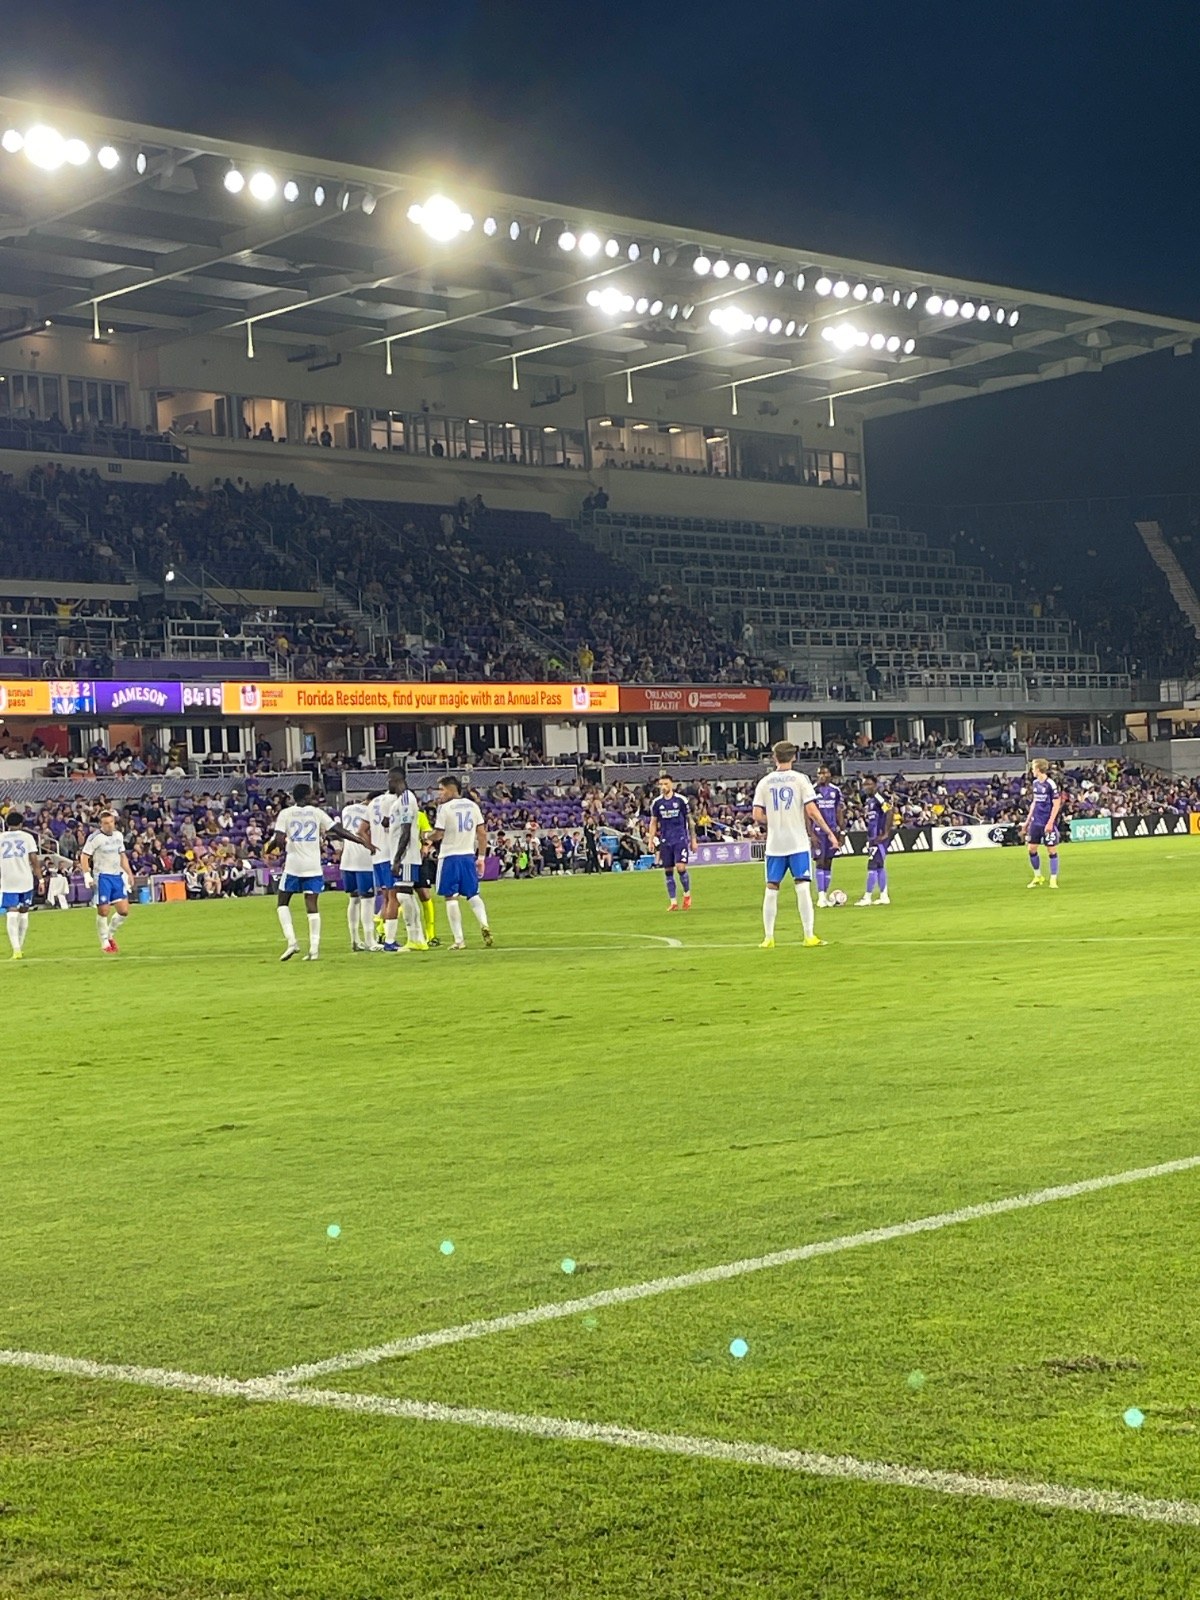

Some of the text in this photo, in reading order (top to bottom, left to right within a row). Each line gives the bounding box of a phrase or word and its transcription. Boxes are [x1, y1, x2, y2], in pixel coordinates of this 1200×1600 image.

[7, 687, 33, 697] annual
[82, 682, 91, 697] 2
[111, 687, 168, 708] JAMESON
[183, 687, 222, 706] 84:15
[8, 698, 26, 708] pass
[84, 698, 90, 712] 1
[297, 690, 562, 709] Florida Residents, find your magic with an Annual Pass
[650, 700, 679, 710] HEALTH
[769, 786, 794, 812] 19
[289, 821, 318, 842] 22
[455, 811, 474, 833] 16
[945, 830, 967, 845] Ford
[1, 840, 26, 859] 23
